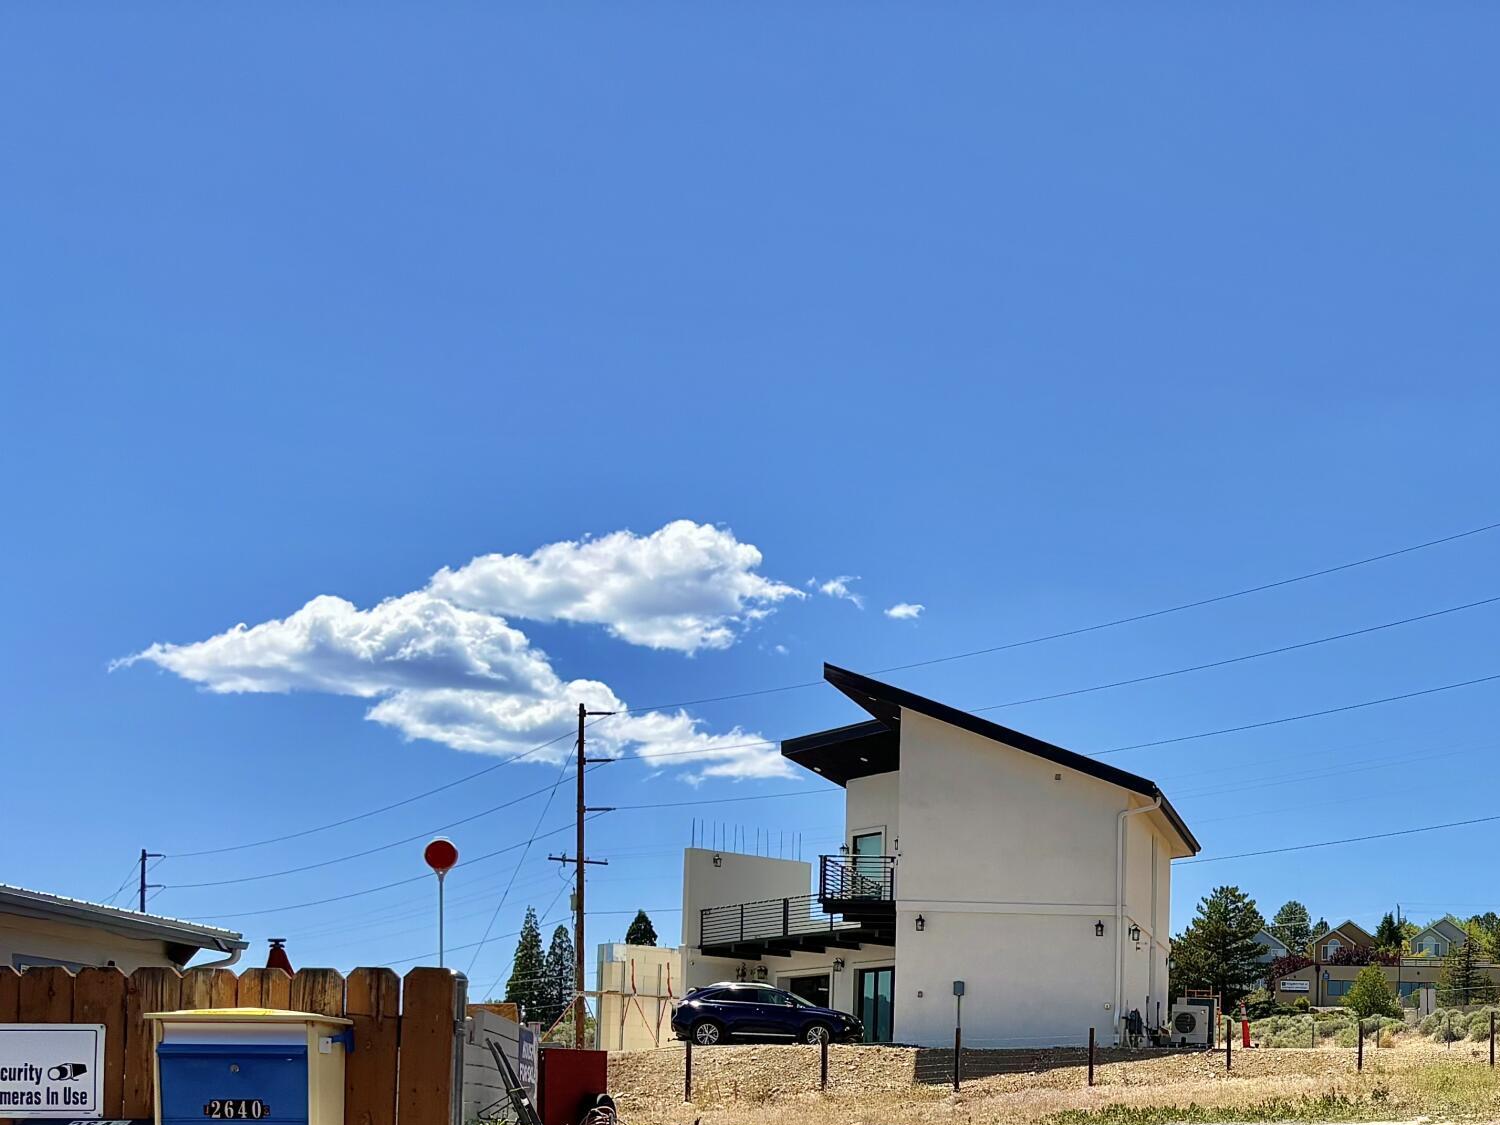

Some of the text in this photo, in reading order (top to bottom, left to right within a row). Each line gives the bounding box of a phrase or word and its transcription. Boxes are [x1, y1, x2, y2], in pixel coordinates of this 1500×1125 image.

[46, 1086, 59, 1105] In
[63, 1087, 88, 1105] Use
[211, 1100, 262, 1118] 2640
